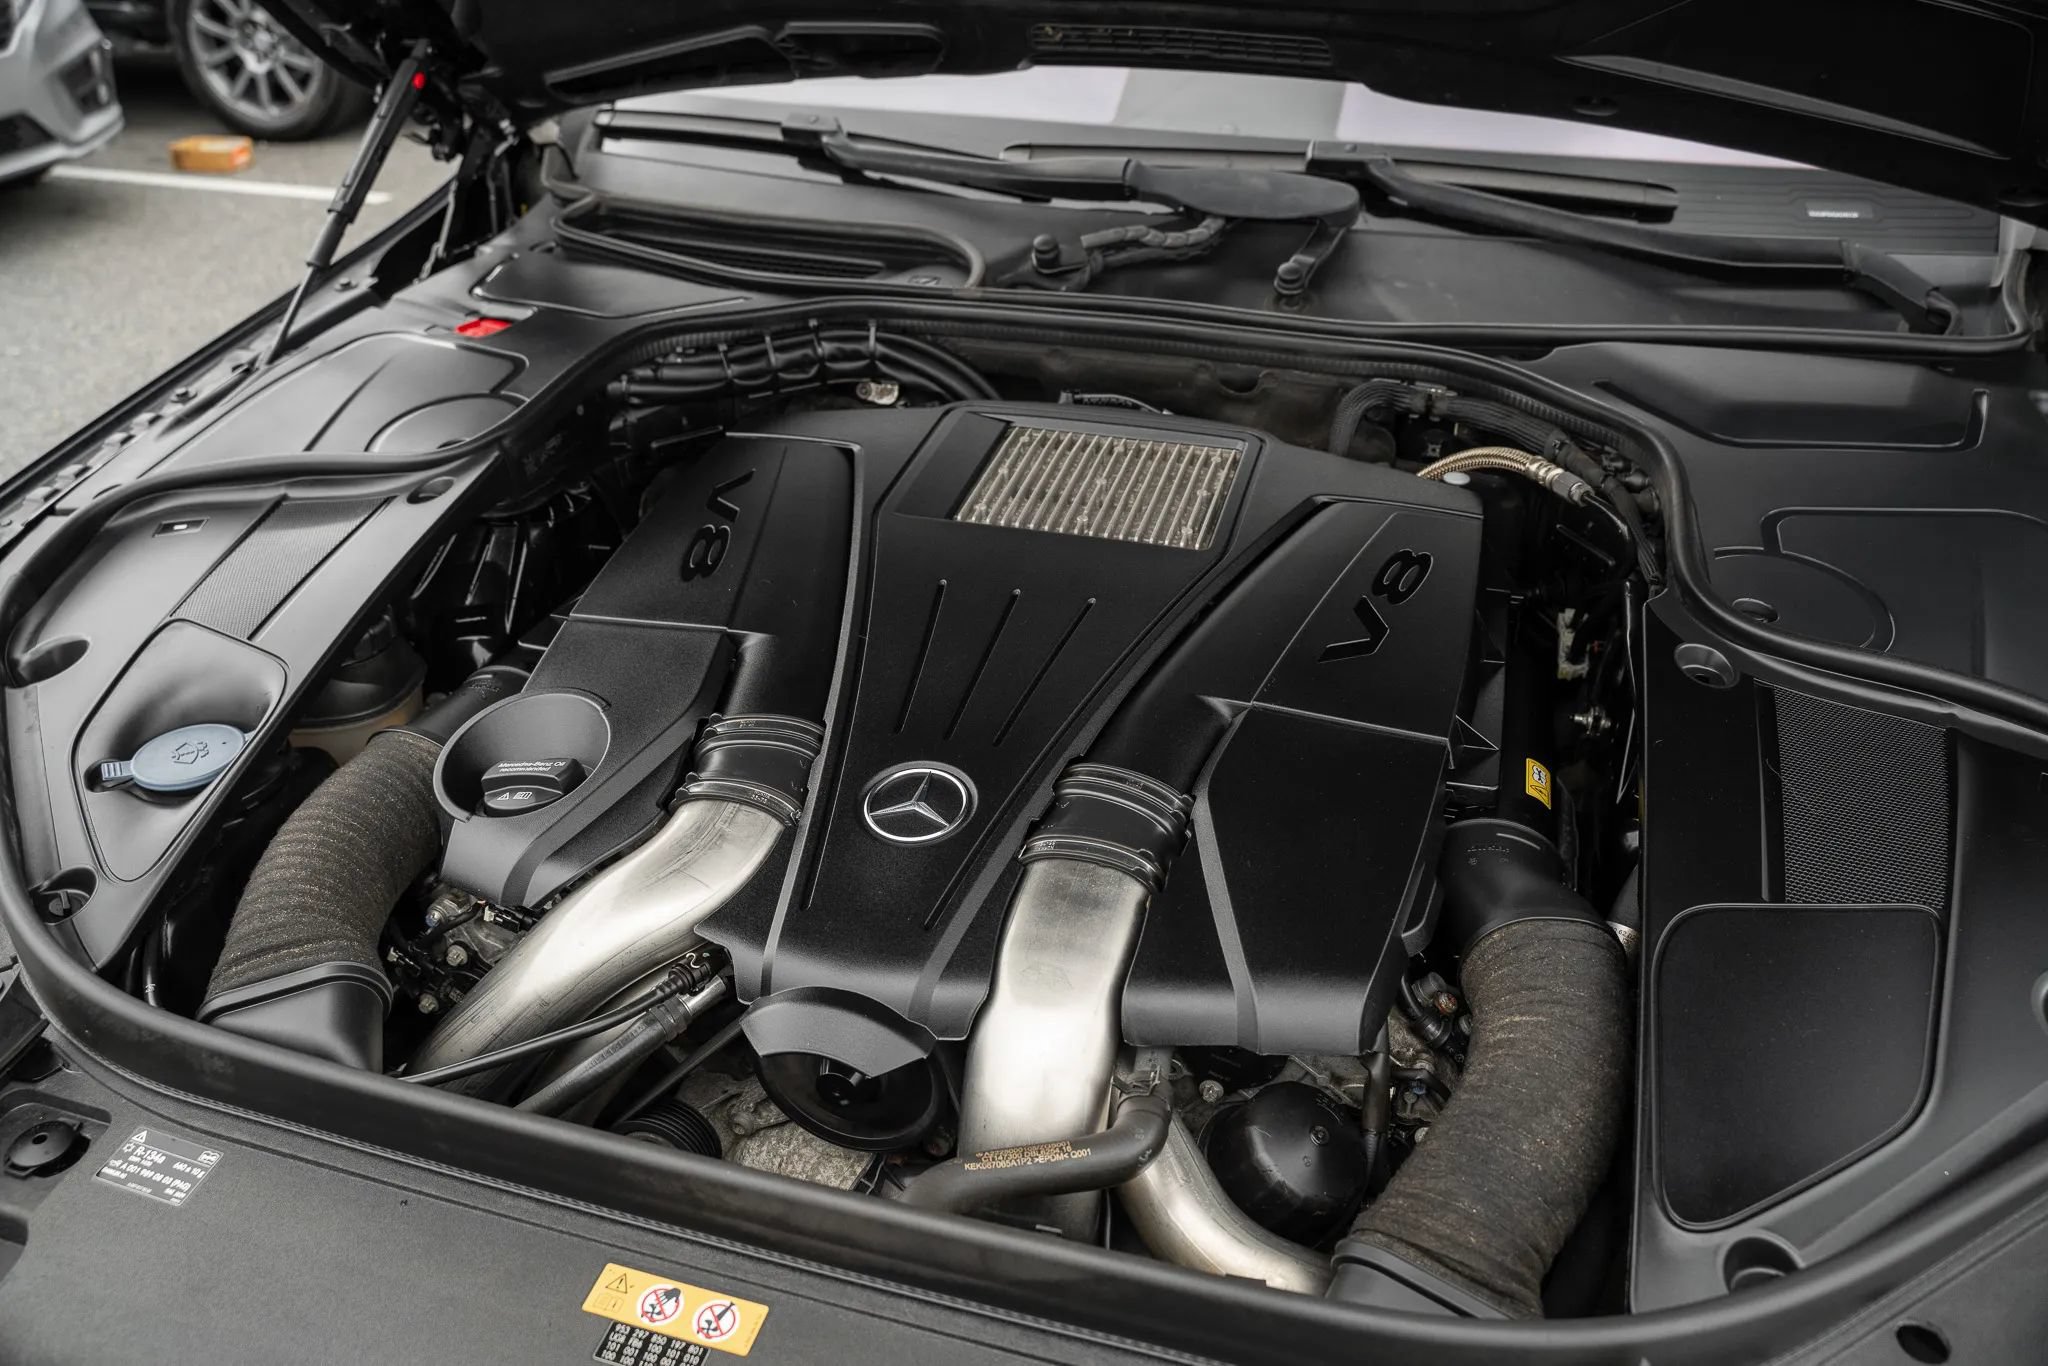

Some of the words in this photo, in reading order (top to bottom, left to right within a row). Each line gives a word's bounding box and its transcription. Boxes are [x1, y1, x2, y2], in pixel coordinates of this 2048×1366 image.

[679, 467, 756, 583] V8
[1317, 547, 1433, 664] V8
[133, 1146, 166, 1164] R-134a
